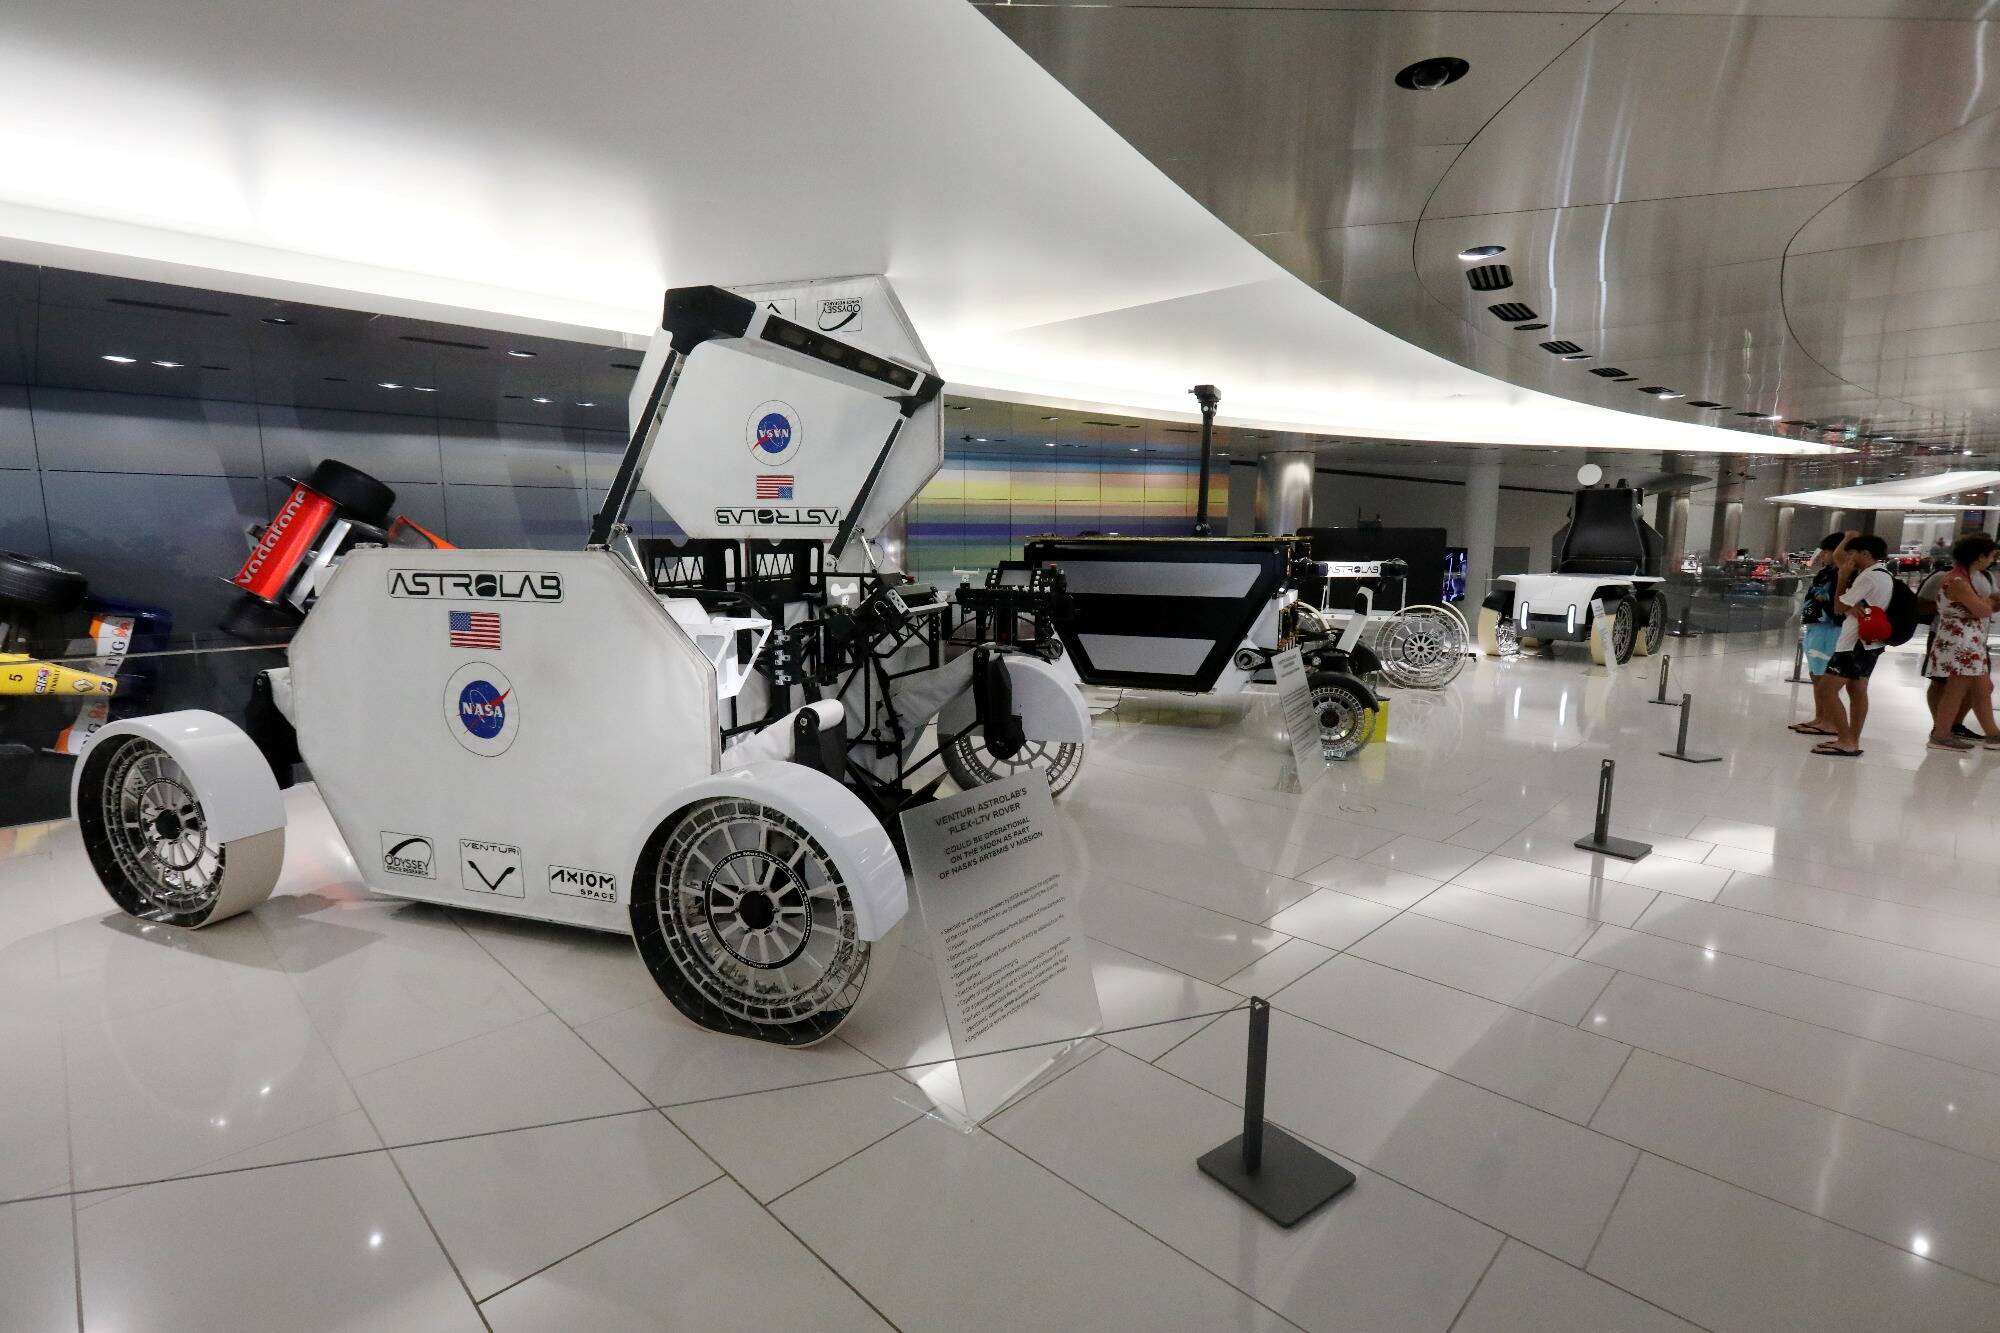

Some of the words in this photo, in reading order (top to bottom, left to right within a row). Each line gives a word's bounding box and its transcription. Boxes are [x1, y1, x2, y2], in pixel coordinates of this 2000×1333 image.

[758, 429, 790, 438] NASA
[716, 509, 839, 525] ASTROLAB
[239, 490, 306, 584] vodafone
[1328, 565, 1379, 574] ASTROLAB
[391, 572, 562, 600] ASTROLAB
[9, 673, 23, 683] 5
[461, 701, 503, 718] NASA
[935, 806, 976, 827] VENTURI
[978, 787, 1028, 811] ASTROLAB'S
[992, 802, 1021, 819] ROVER
[945, 839, 972, 855] COULD
[973, 834, 983, 844] BE
[984, 816, 1031, 839] OPERATIONAL
[462, 841, 520, 856] VENTURI
[950, 853, 963, 864] ON
[964, 847, 979, 858] THE
[980, 839, 1002, 852] MOON
[1003, 833, 1012, 842] AS
[1013, 825, 1030, 839] PART
[385, 854, 429, 871] ODYSSEY
[939, 870, 950, 880] OF
[951, 858, 978, 875] NASA'S
[979, 845, 1009, 863] ARTEMIS
[1016, 830, 1043, 848] MISSION
[551, 869, 614, 890] AXIOM
[580, 888, 615, 901] SPACE
